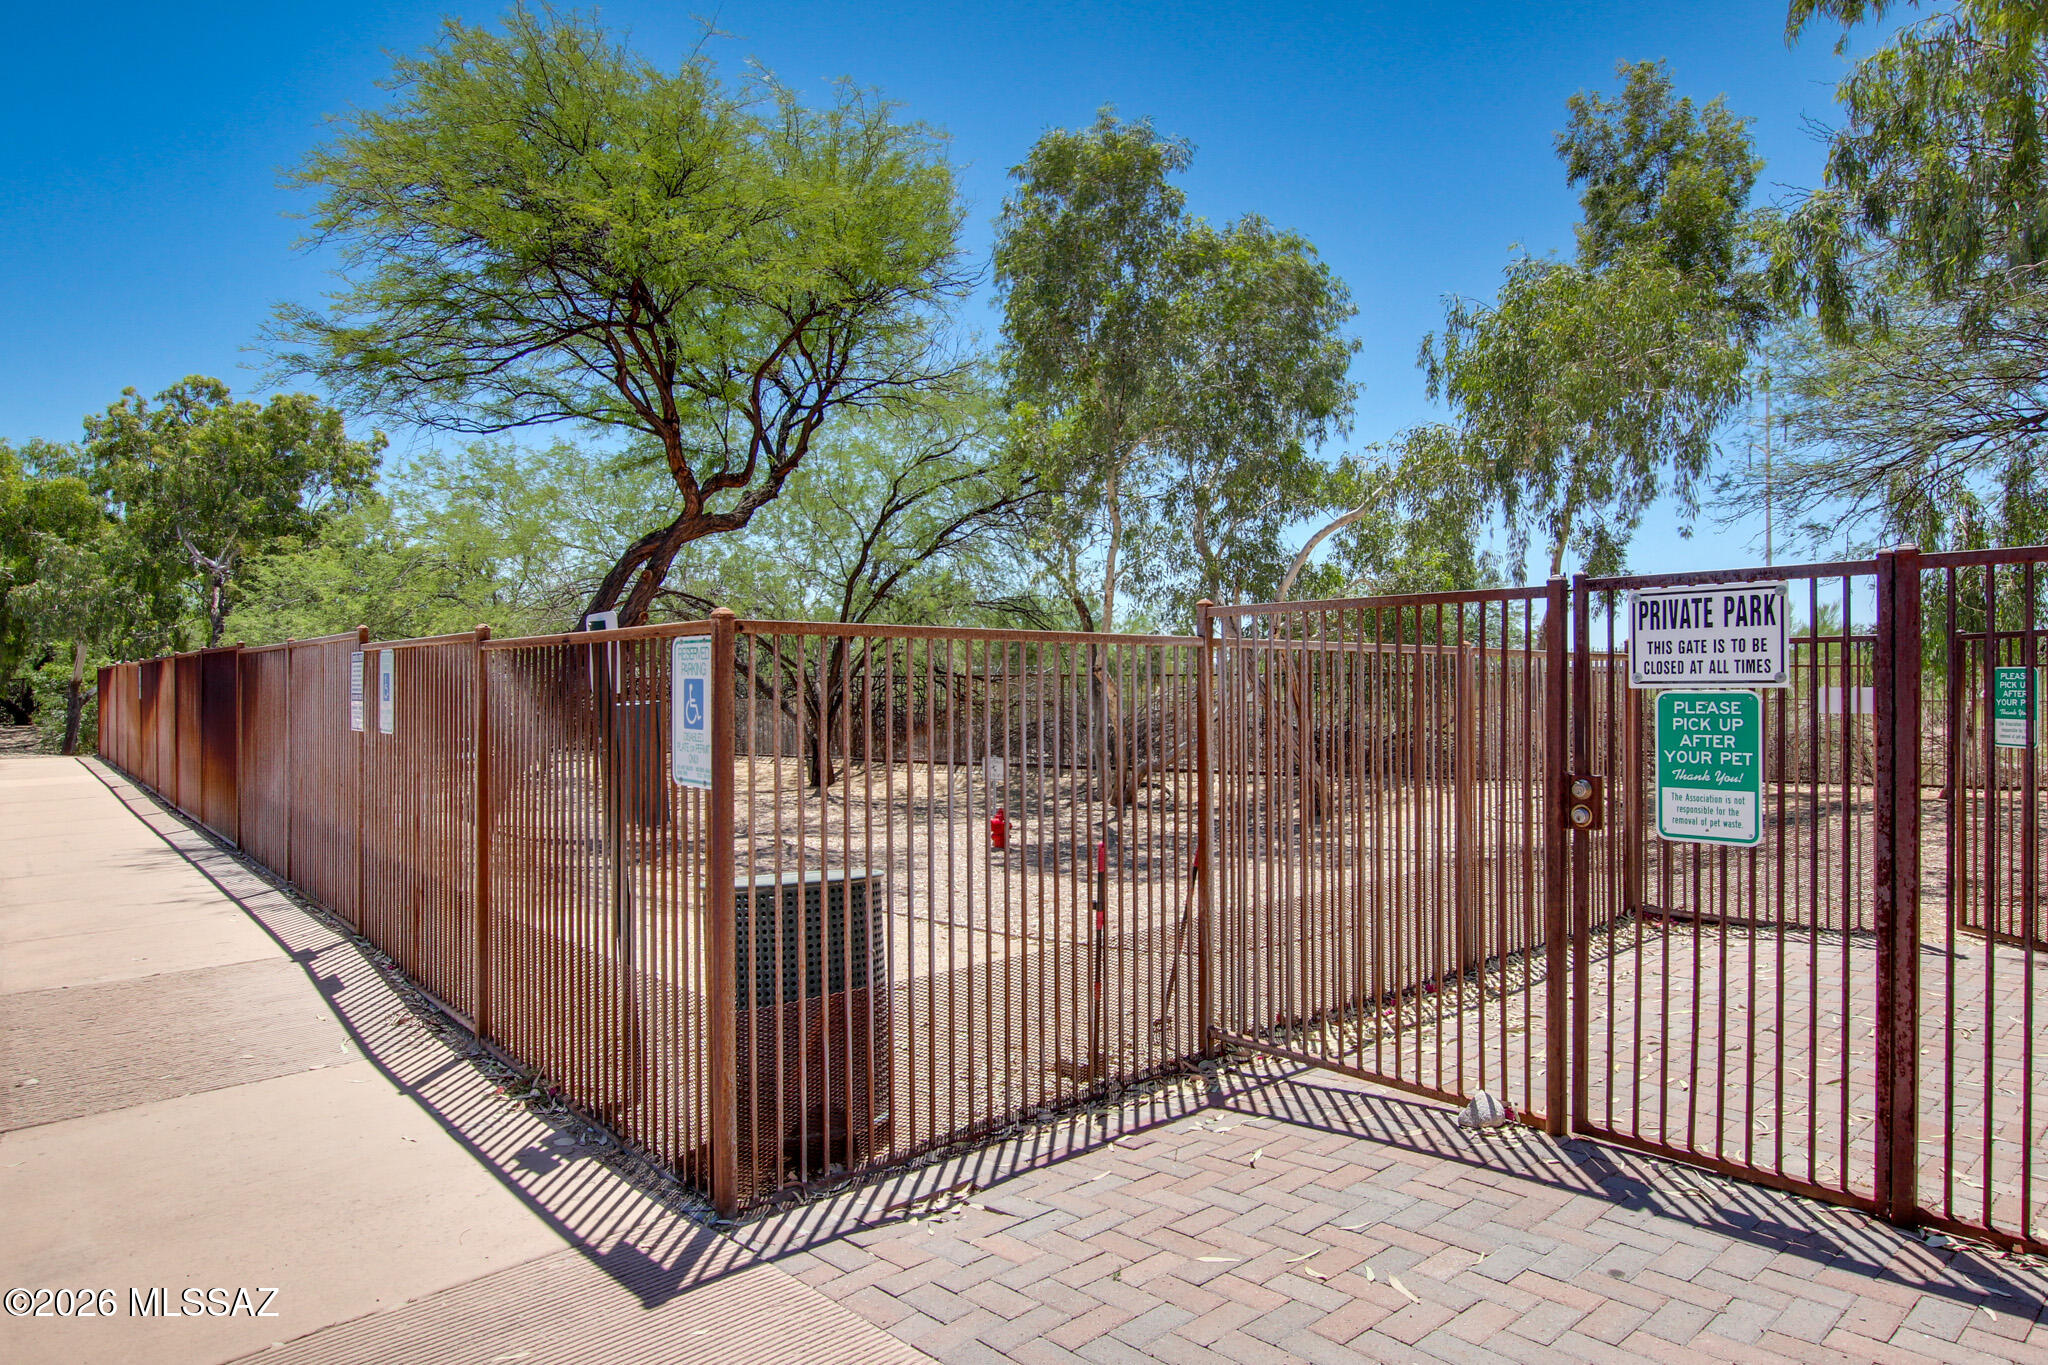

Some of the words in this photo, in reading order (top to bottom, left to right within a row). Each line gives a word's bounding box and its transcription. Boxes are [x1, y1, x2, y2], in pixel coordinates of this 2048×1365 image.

[1638, 596, 1714, 631] PRIVATE
[1723, 593, 1776, 628] PARK
[1647, 640, 1673, 655] THIS
[1678, 639, 1708, 655] GATE
[1713, 639, 1725, 653] IS
[1730, 638, 1746, 653] TO
[1752, 637, 1768, 652] BE
[681, 661, 706, 676] PARKING
[1643, 660, 1684, 675] CLOSED
[1690, 660, 1703, 674] AT
[1709, 659, 1729, 674] ALL
[1734, 658, 1771, 674] TIMES
[1673, 701, 1742, 715] PLEASE
[1672, 717, 1711, 731] PICK
[1719, 718, 1744, 732] UP
[1680, 734, 1736, 749] AFTER
[1664, 750, 1712, 764] YOUR
[1720, 752, 1753, 767] PET
[1671, 768, 1711, 782] Thank
[1714, 769, 1744, 785] You!
[1671, 792, 1683, 801] The
[1685, 793, 1723, 804] Association
[1725, 796, 1732, 805] is
[1734, 796, 1745, 805] not
[1676, 805, 1714, 815] responsible
[1716, 806, 1726, 815] for
[1728, 807, 1740, 817] the
[1671, 816, 1698, 826] removal
[1700, 817, 1708, 826] of
[1709, 818, 1721, 828] pet
[1723, 820, 1743, 829] waste.
